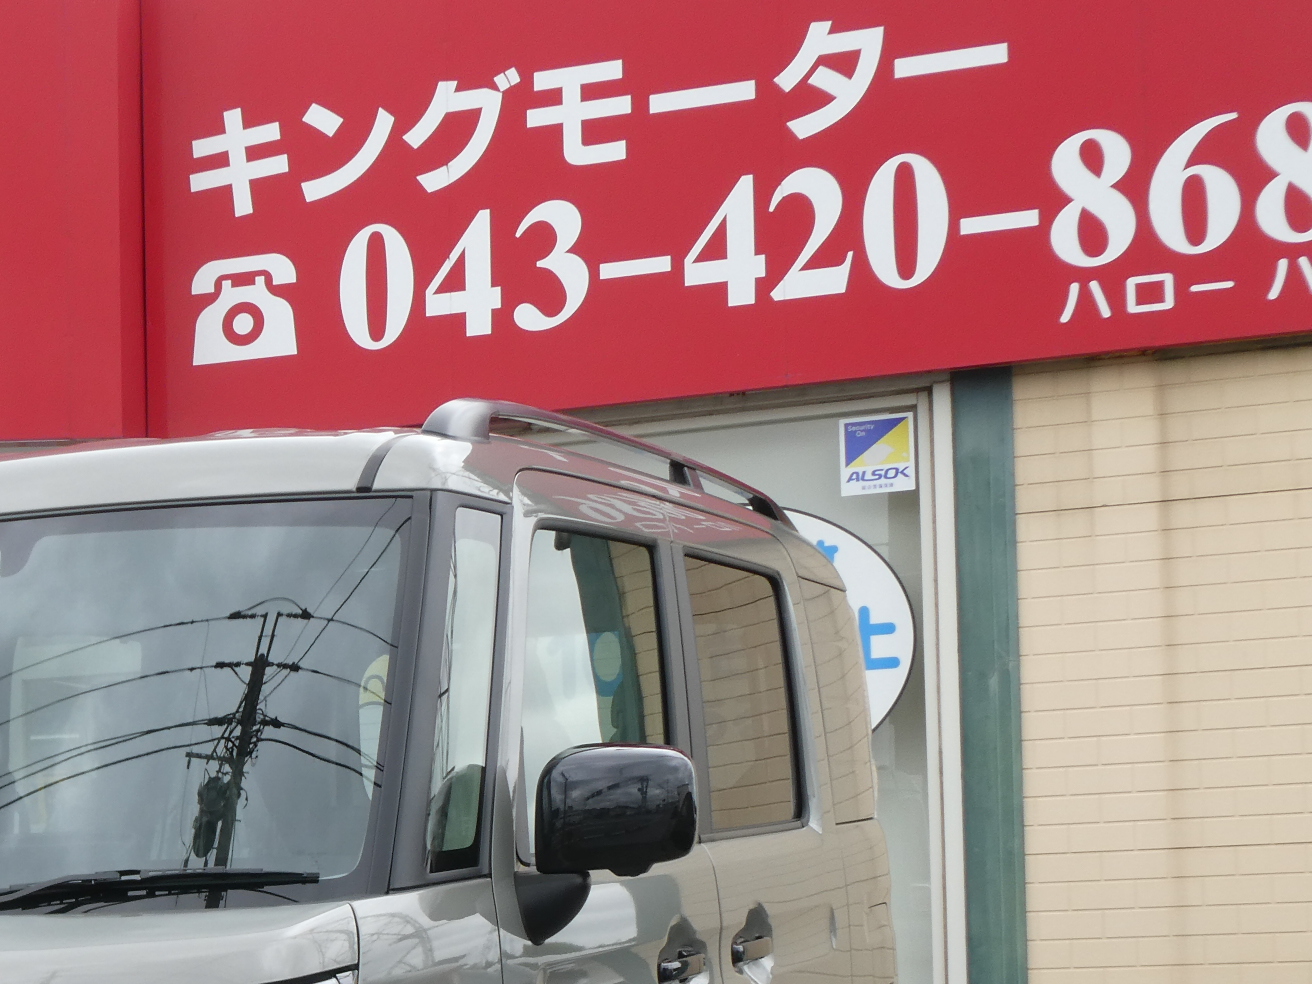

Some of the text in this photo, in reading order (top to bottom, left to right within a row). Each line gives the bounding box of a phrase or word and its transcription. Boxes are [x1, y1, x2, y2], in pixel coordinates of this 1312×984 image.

[189, 19, 1009, 218] キングモーター
[1059, 272, 1235, 323] ハロー
[846, 466, 910, 484] ALSOK
